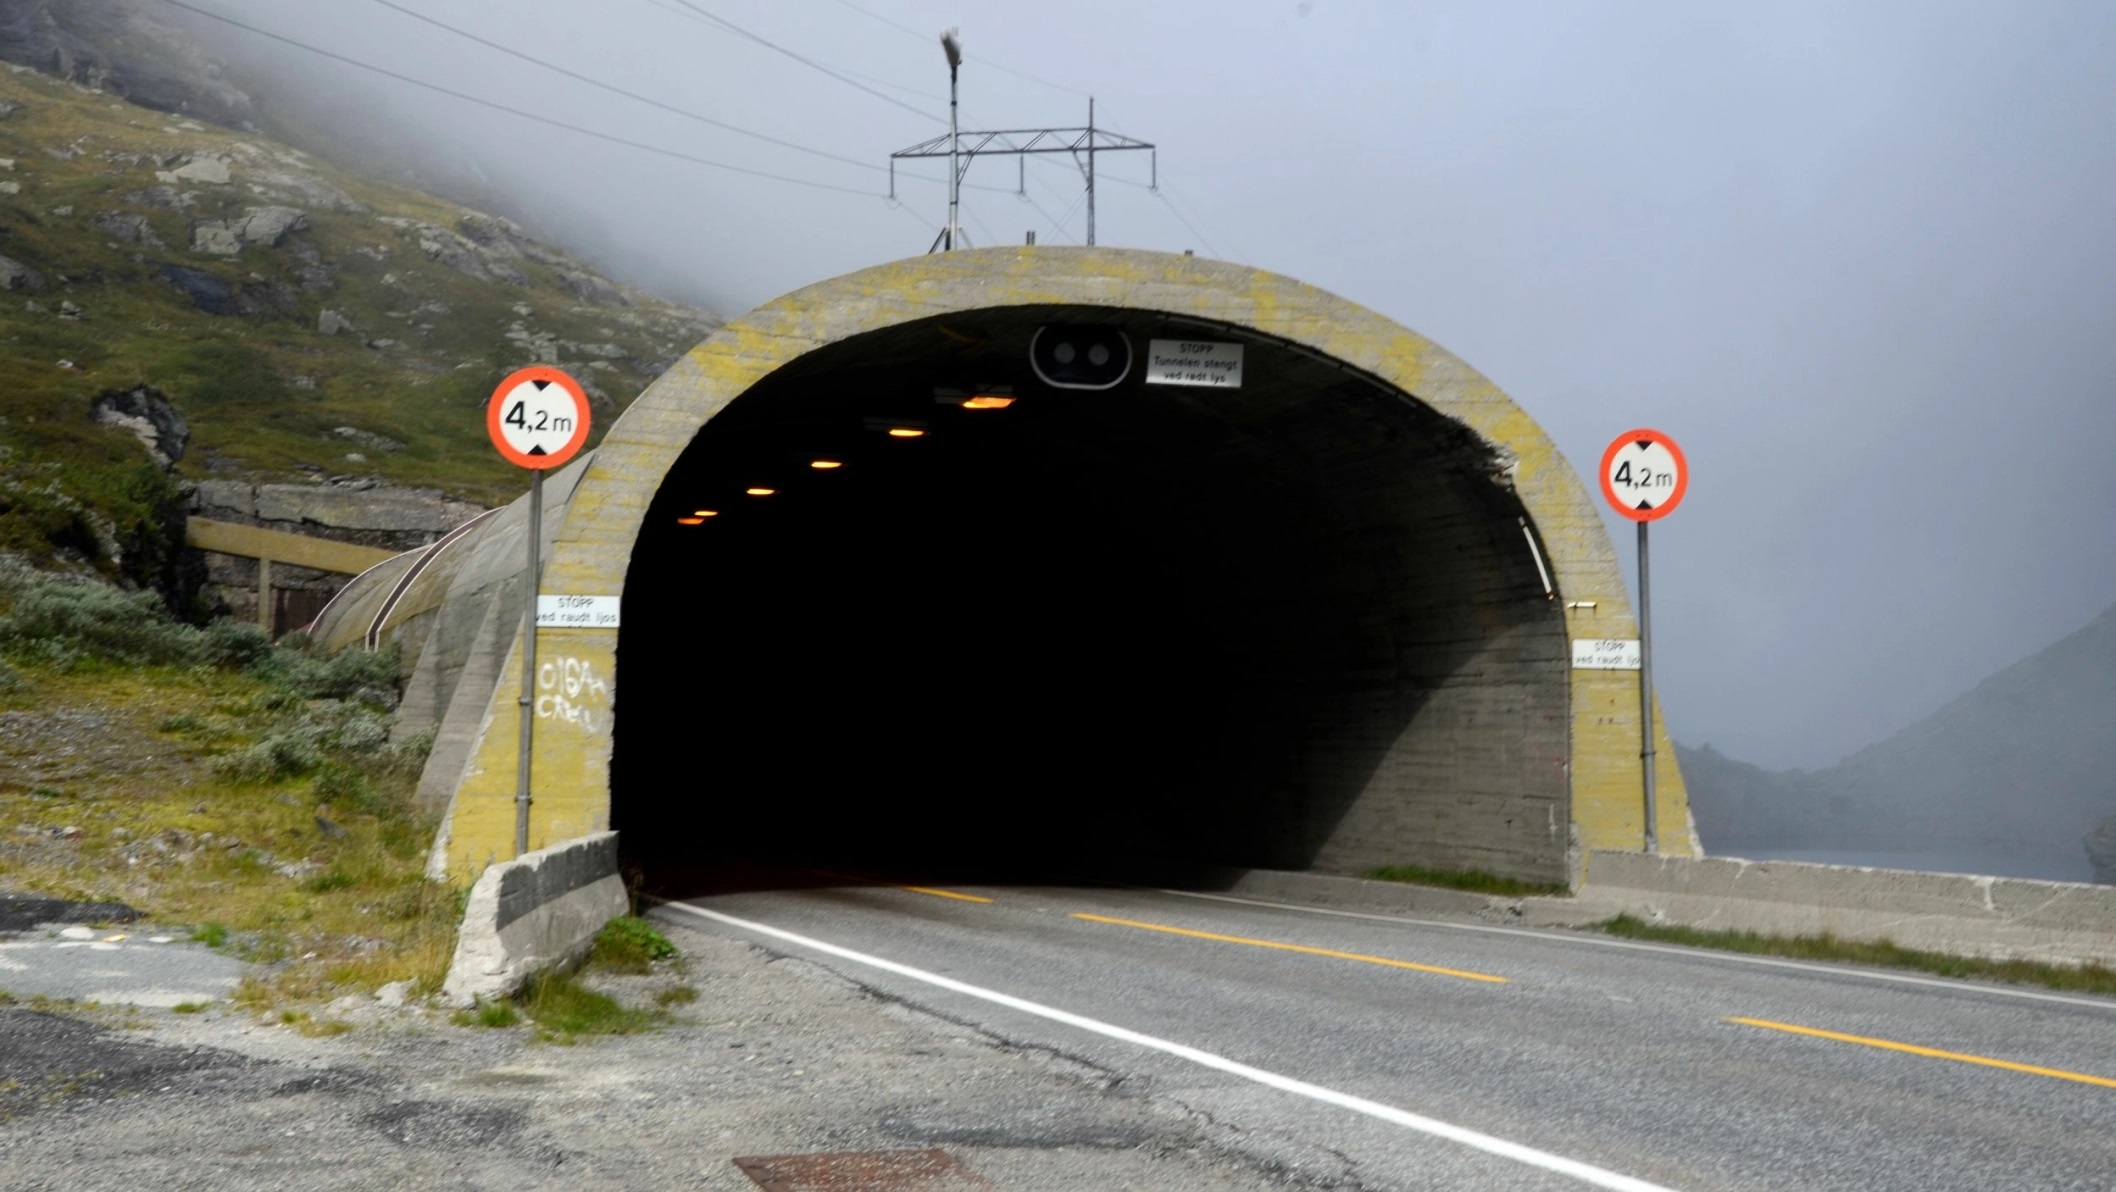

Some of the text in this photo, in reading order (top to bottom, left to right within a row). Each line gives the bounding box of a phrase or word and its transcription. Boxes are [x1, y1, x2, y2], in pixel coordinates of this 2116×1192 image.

[1179, 343, 1214, 354] STOPP
[1154, 355, 1200, 368] Tunnelen
[505, 400, 572, 434] 4,2 m
[1614, 460, 1672, 490] 4,2 m
[558, 597, 594, 608] STOPP
[1594, 641, 1625, 652] STOPP
